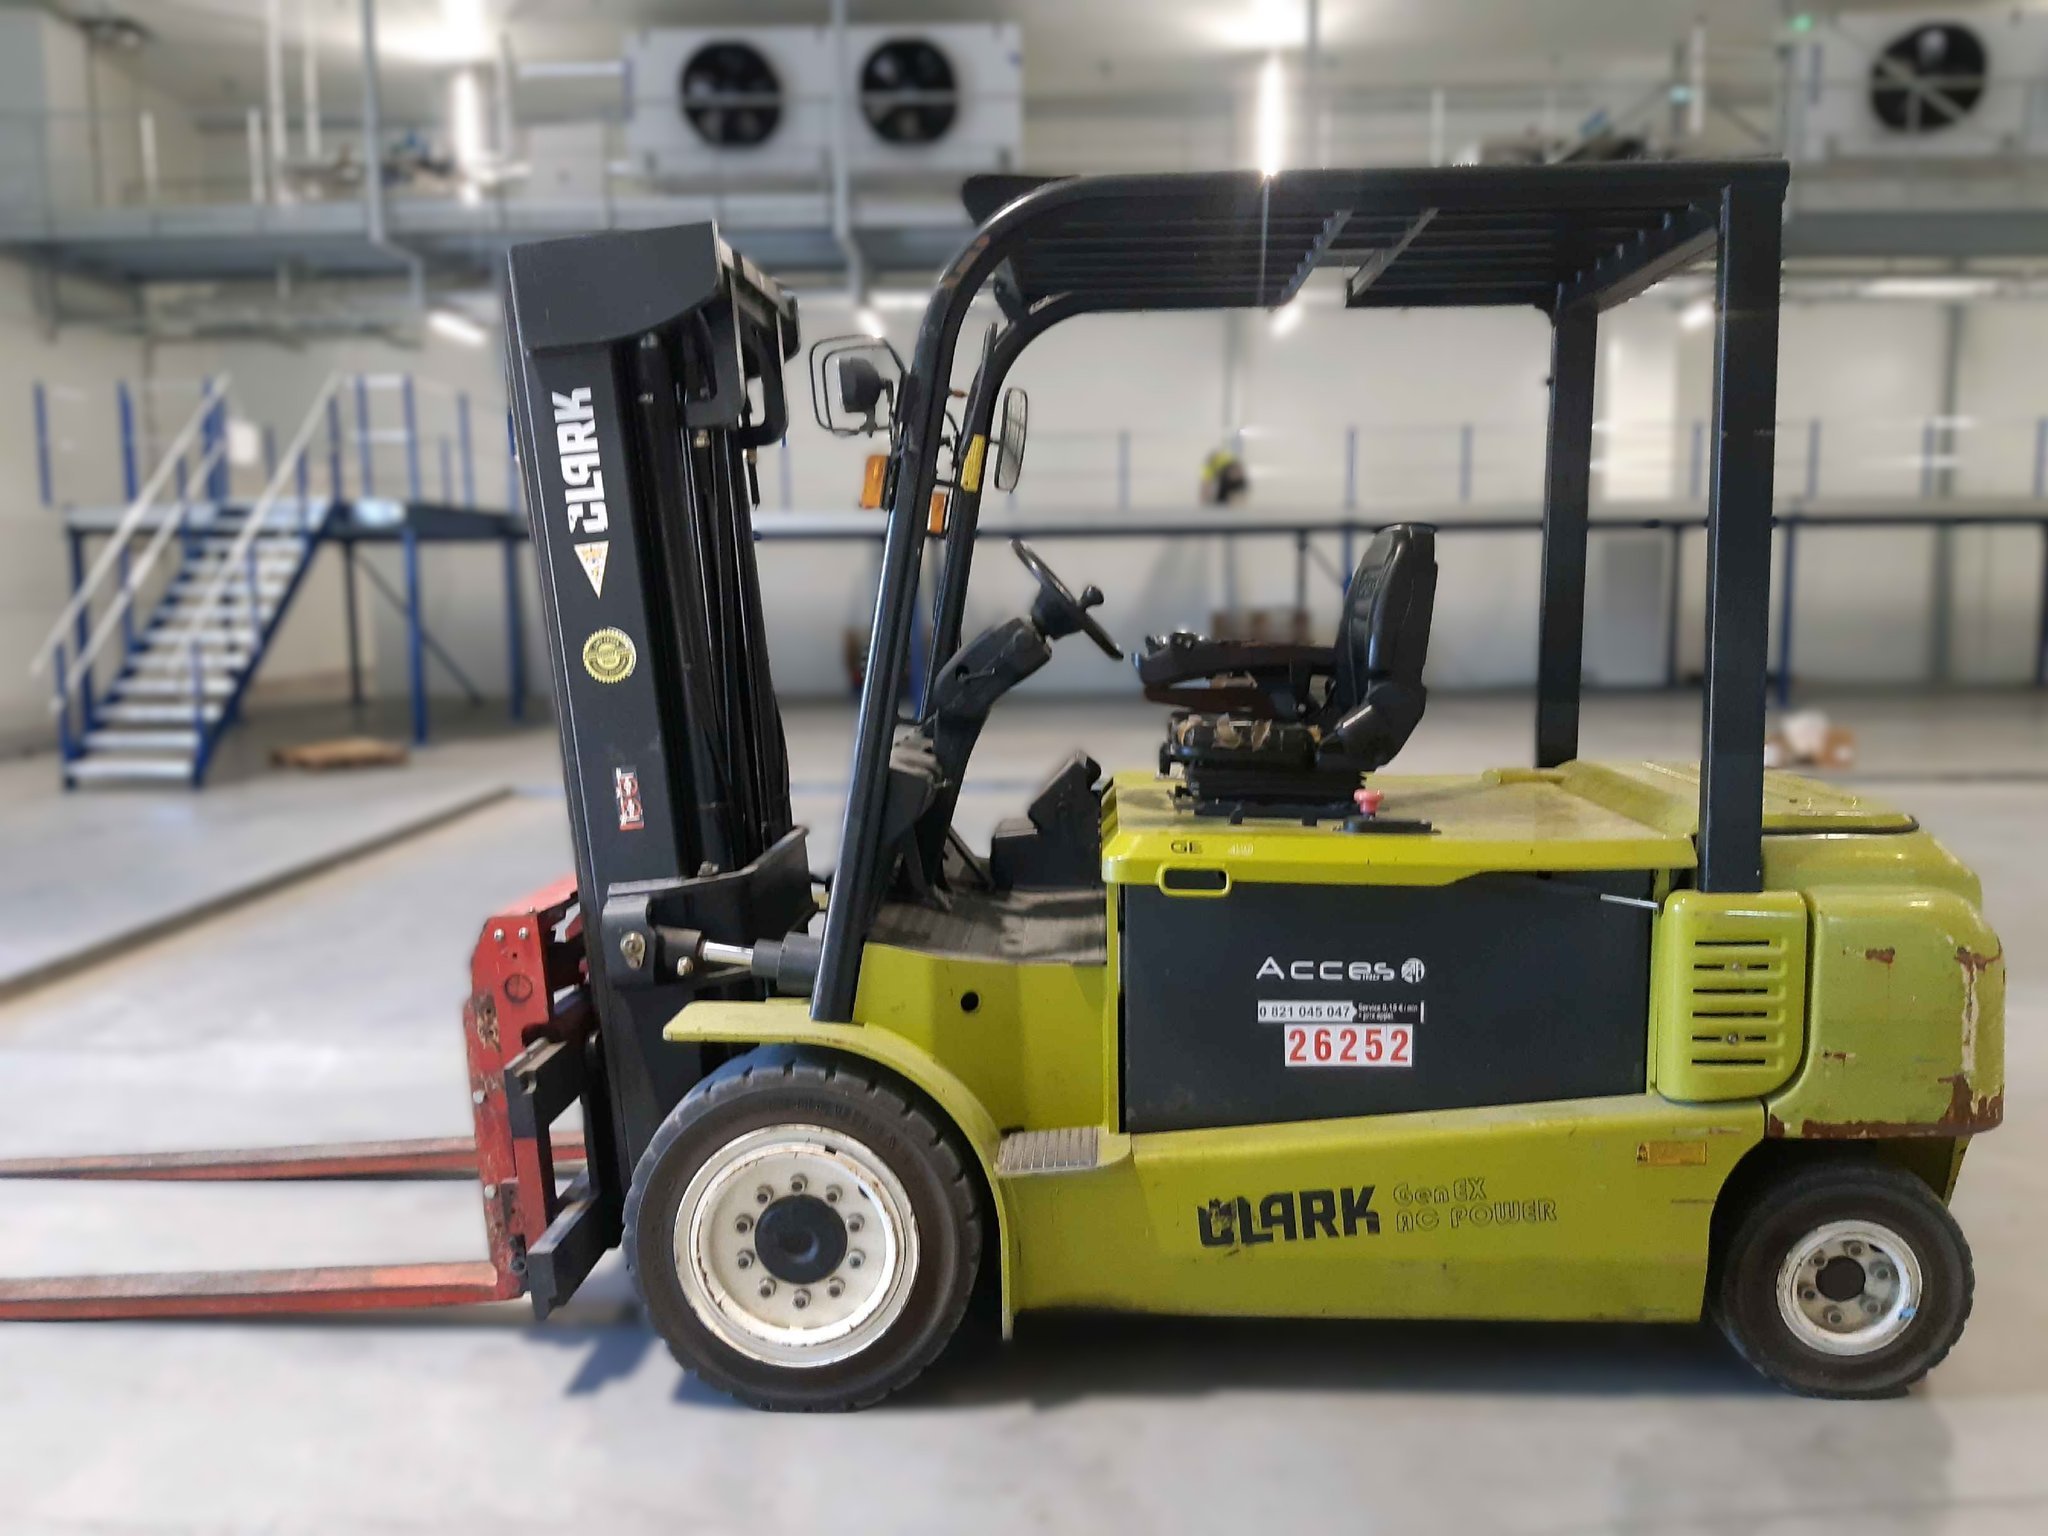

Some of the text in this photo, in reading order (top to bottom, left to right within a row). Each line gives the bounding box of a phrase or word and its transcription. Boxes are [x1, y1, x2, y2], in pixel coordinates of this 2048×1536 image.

[552, 387, 609, 534] CLARK
[1259, 1005, 1350, 1018] 0 821 045 047
[1289, 1029, 1408, 1063] 26252
[1197, 1185, 1380, 1247] CLARK
[1395, 1199, 1558, 1233] AC POWER
